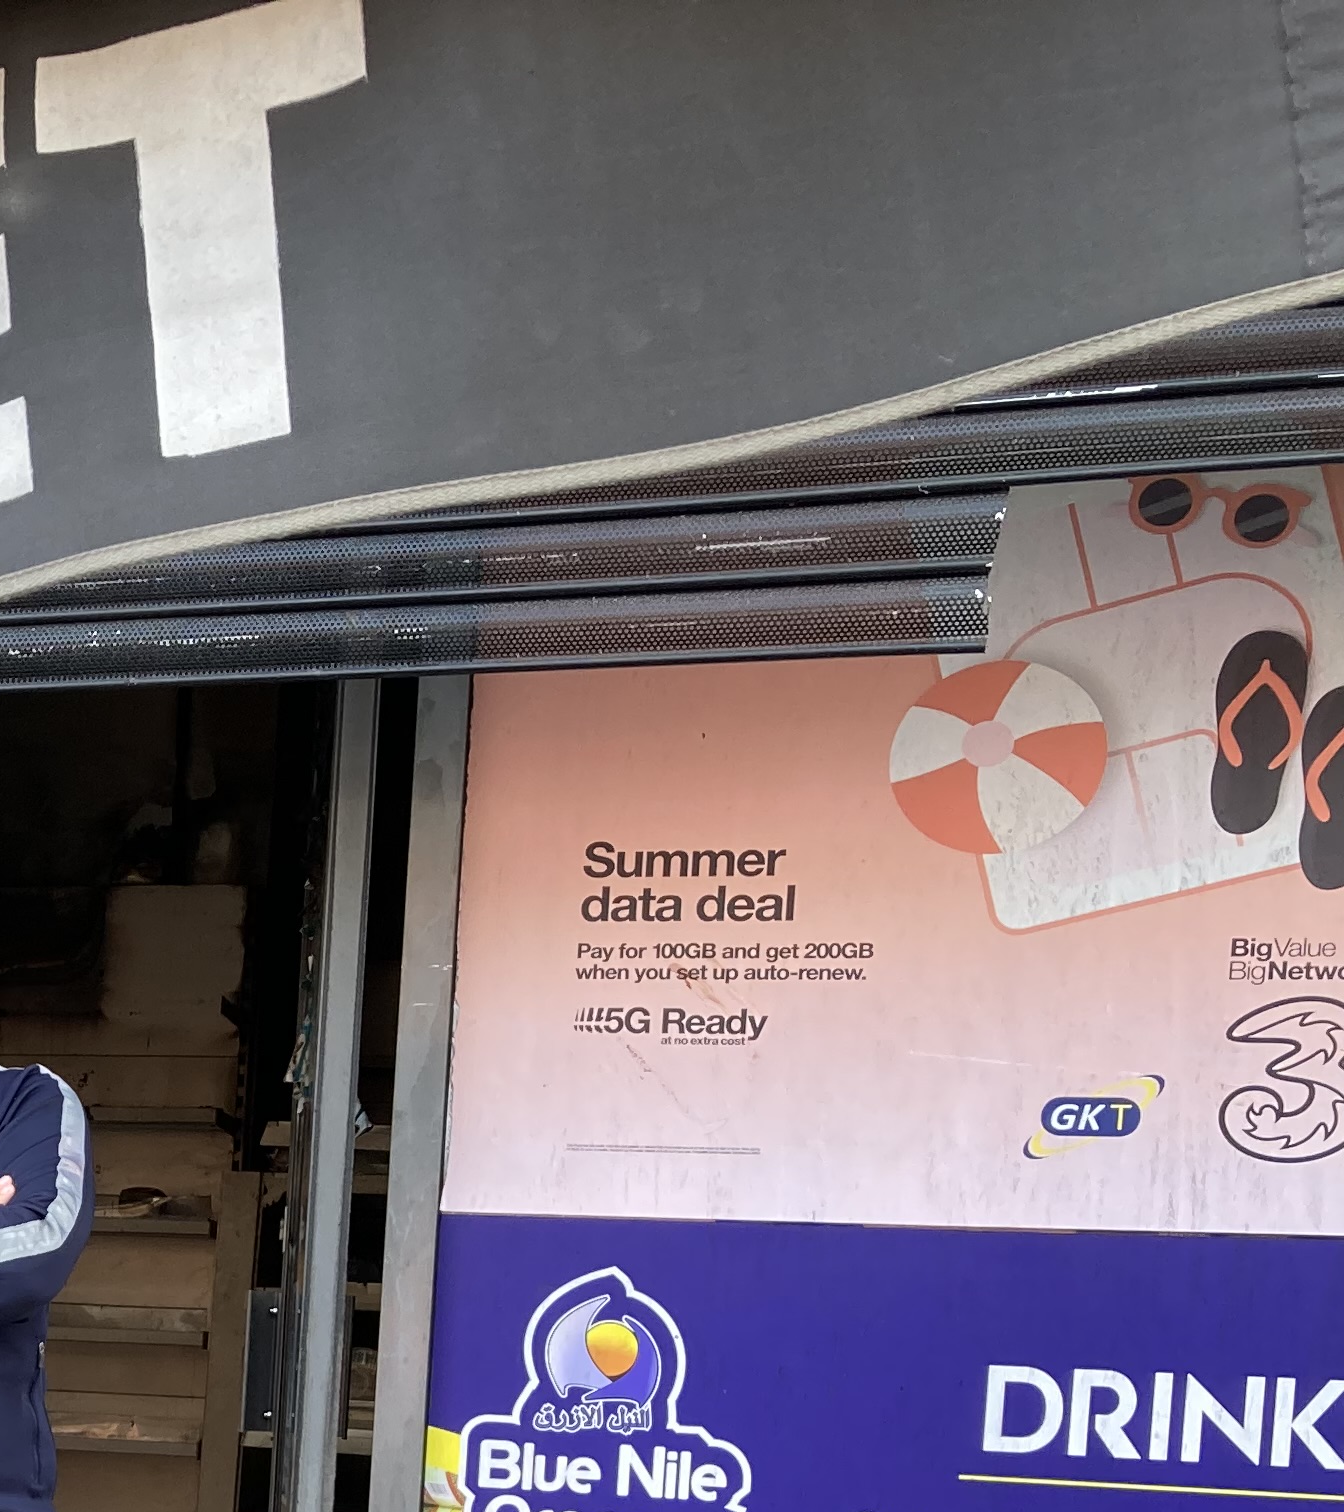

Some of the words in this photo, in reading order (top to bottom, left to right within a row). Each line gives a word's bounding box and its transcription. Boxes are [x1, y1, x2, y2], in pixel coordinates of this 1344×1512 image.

[583, 841, 787, 878] Summer
[580, 886, 682, 922] data
[696, 885, 796, 921] deal
[577, 943, 614, 962] Pay
[618, 943, 647, 960] for
[652, 943, 716, 960] 100GB
[721, 943, 760, 959] and
[765, 943, 800, 962] get
[803, 943, 874, 960] 200GB
[575, 964, 629, 980] when
[634, 966, 671, 984] you
[676, 965, 708, 980] set
[712, 967, 739, 984] up
[743, 964, 867, 981] auto-renew.
[661, 1008, 769, 1041] Ready
[660, 1037, 672, 1046] at
[674, 1038, 688, 1046] no
[689, 1037, 719, 1046] extra
[719, 1037, 746, 1046] cost
[1050, 1103, 1133, 1131] GKT
[982, 1364, 1344, 1470] DRINK
[477, 1439, 602, 1494] Blue
[616, 1443, 728, 1502] Nile
